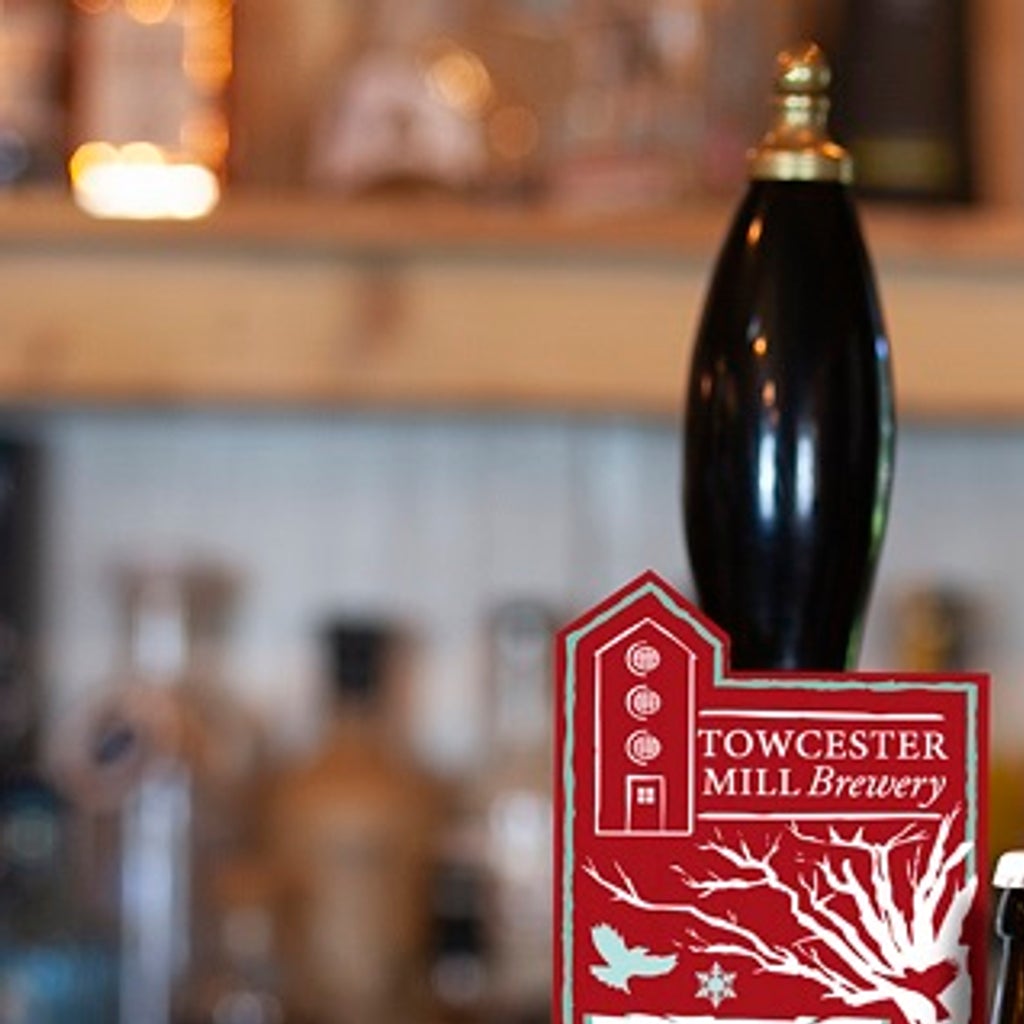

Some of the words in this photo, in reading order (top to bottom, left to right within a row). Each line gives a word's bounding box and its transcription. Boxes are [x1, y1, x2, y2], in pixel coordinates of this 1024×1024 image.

[697, 729, 949, 760] TOWCESTER
[703, 767, 799, 796] MILL
[807, 765, 947, 809] Brewery
